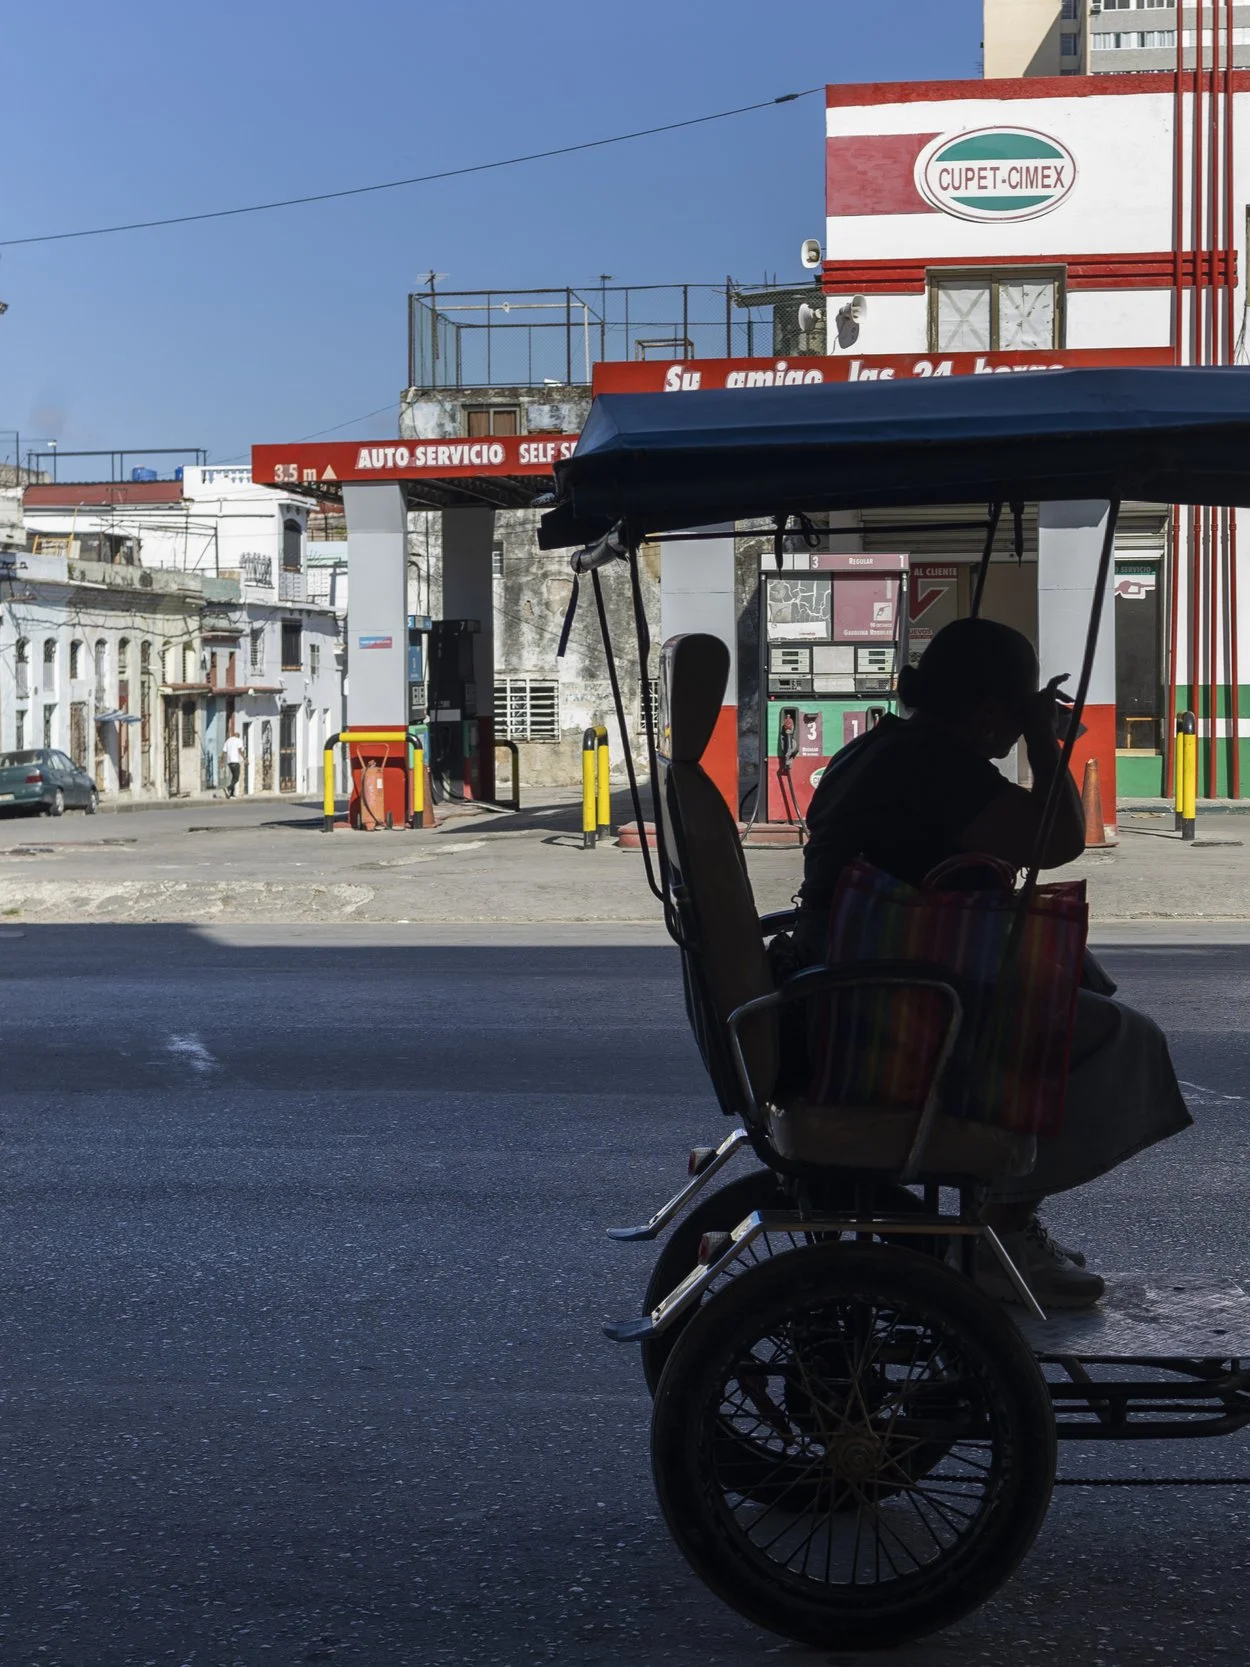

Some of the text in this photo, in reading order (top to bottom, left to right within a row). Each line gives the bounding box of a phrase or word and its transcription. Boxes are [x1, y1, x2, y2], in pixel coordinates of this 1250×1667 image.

[938, 165, 1065, 191] CUPET-CIMEX
[664, 364, 701, 392] Su
[357, 446, 409, 469] AUTO
[415, 443, 504, 467] SERVICIO
[519, 442, 555, 464] SELF
[274, 464, 317, 482] 3.5 m
[812, 555, 819, 569] 3
[899, 555, 904, 568] 1
[913, 567, 957, 576] AL CLIENTE
[460, 621, 466, 631] 7
[807, 722, 817, 740] 3
[852, 720, 859, 738] 1
